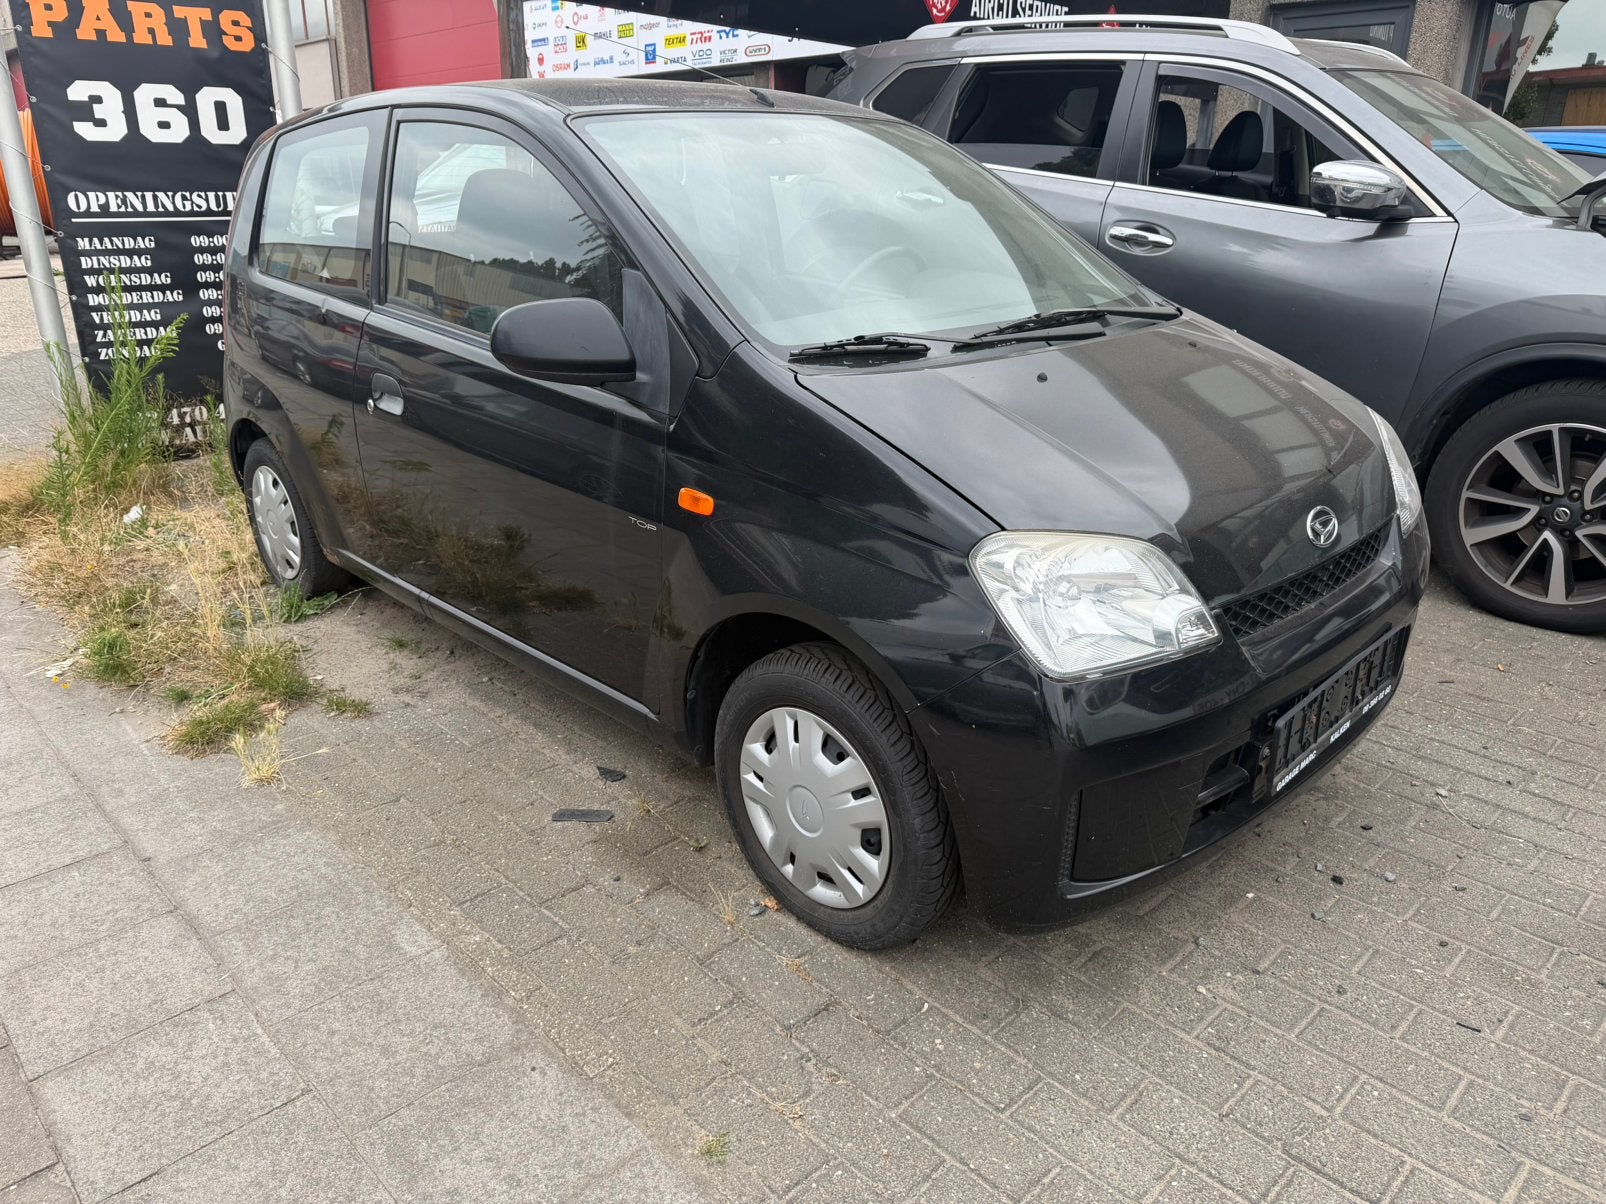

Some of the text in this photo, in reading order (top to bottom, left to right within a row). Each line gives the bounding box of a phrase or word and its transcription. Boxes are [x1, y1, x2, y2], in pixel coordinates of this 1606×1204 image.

[25, 0, 255, 52] PARTS
[664, 35, 687, 46] TEXTAR
[690, 29, 713, 45] TRW
[717, 28, 739, 40] TYC
[669, 56, 687, 64] VARTA
[692, 49, 713, 58] VDO
[552, 63, 571, 72] OSRAM
[66, 79, 248, 145] 360
[75, 236, 155, 250] MAANDAG
[80, 253, 225, 268] DINSDAG 09:0
[628, 516, 657, 530] TOP
[1276, 764, 1301, 792] GARAGE
[1300, 750, 1317, 771] MARC
[1329, 720, 1351, 744] KALKEN
